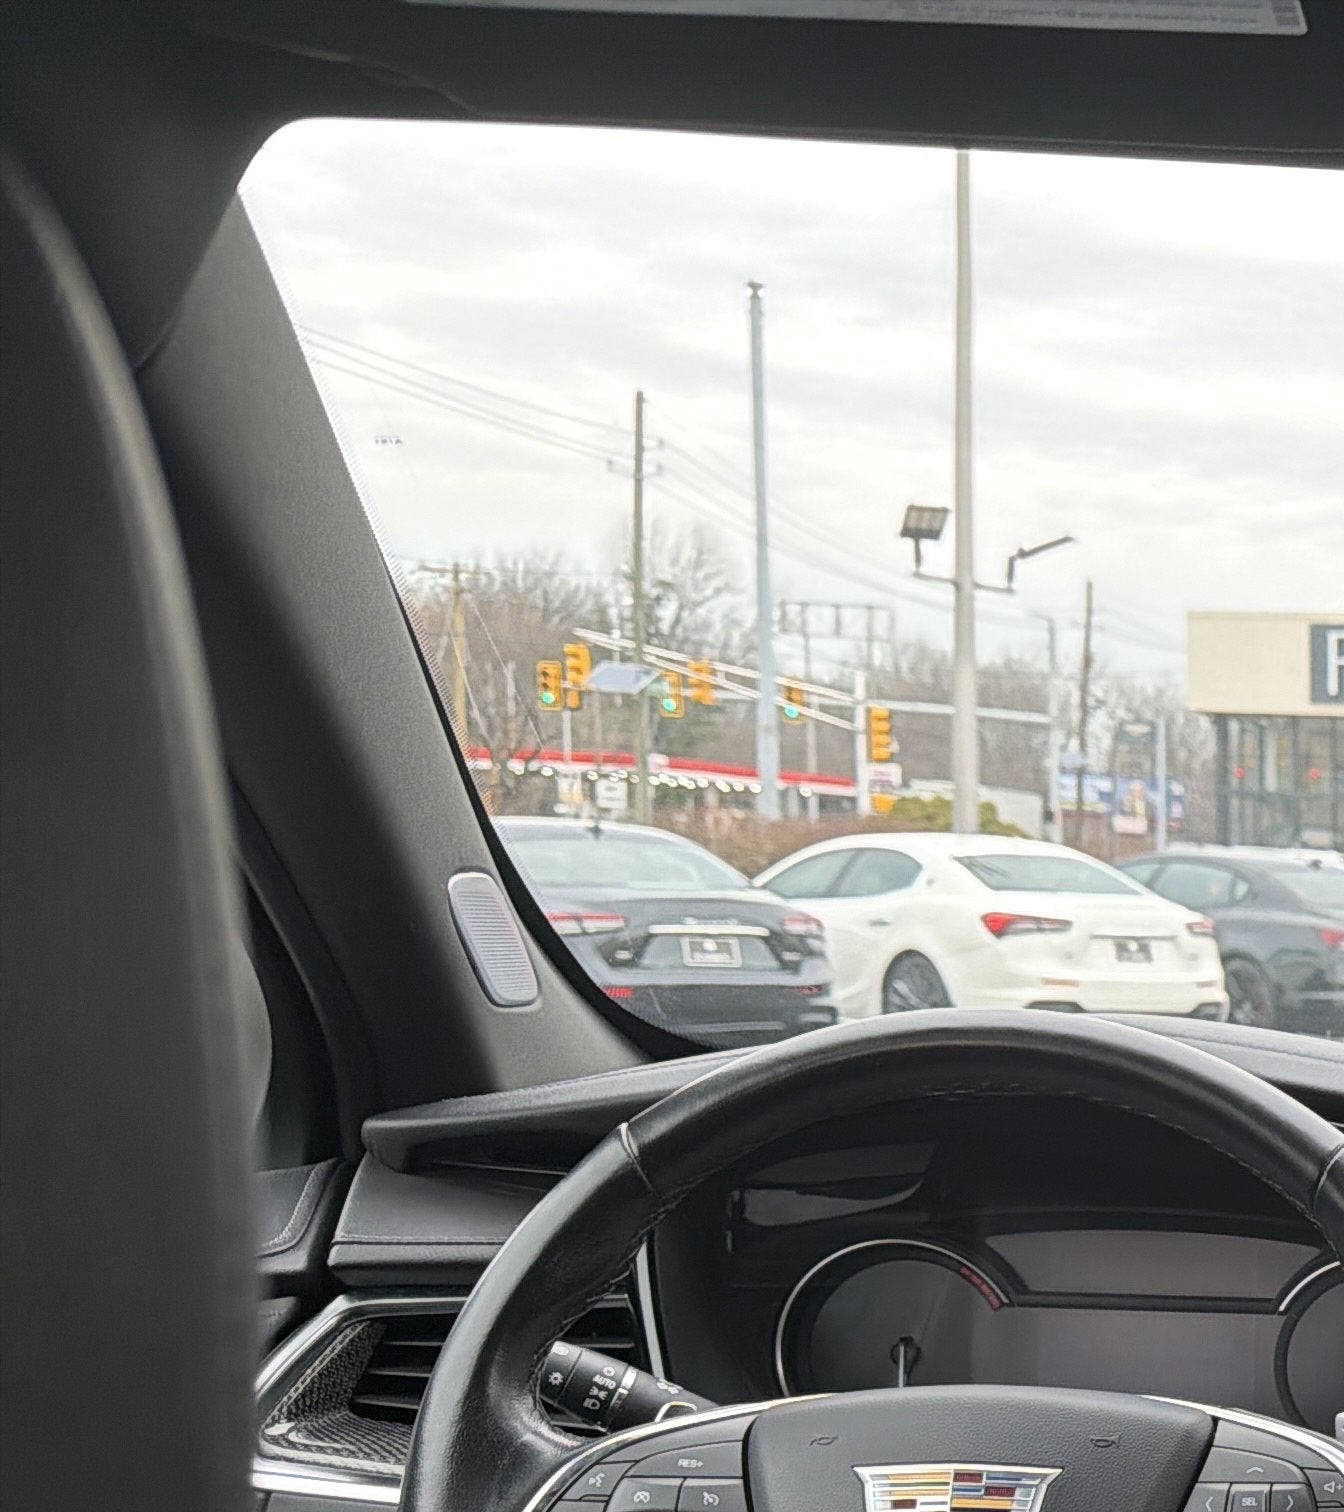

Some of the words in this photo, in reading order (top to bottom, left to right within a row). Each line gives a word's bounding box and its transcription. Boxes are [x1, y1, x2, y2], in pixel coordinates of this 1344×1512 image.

[591, 1373, 617, 1391] AUTO
[677, 1458, 705, 1470] RES+
[1240, 1496, 1259, 1508] SEL
